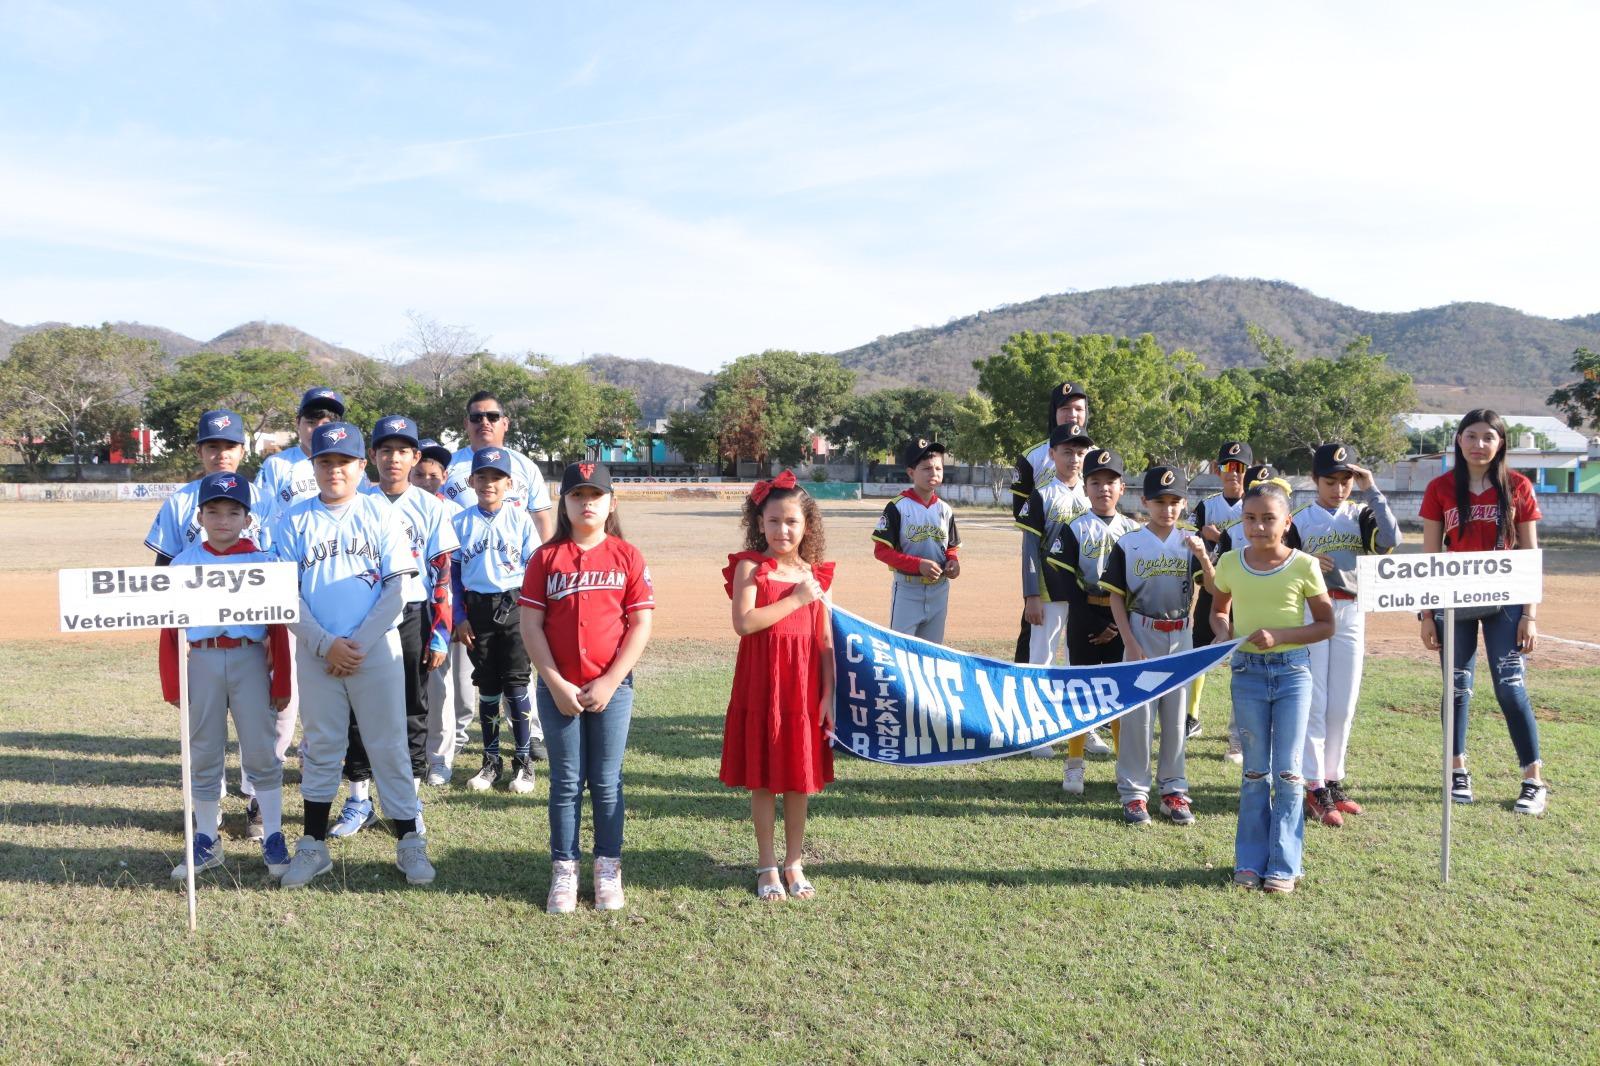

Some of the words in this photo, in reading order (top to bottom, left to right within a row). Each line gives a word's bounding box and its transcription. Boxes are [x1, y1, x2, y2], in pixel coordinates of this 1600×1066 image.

[1070, 424, 1081, 436] C
[1097, 451, 1112, 465] C
[1229, 443, 1241, 455] C
[1333, 447, 1347, 462] C
[1160, 470, 1176, 486] C
[1256, 467, 1269, 480] C
[281, 478, 317, 502] BLUE
[1377, 555, 1513, 580] Cachorros
[92, 569, 171, 594] Blue
[184, 565, 266, 593] Jays
[546, 568, 626, 596] MAZATLÁN
[1378, 593, 1415, 608] Club
[1420, 592, 1440, 605] de
[1453, 590, 1510, 604] Leones
[63, 610, 190, 630] Veterinaria
[218, 605, 296, 623] Potrillo
[975, 668, 1124, 749] MAYOR
